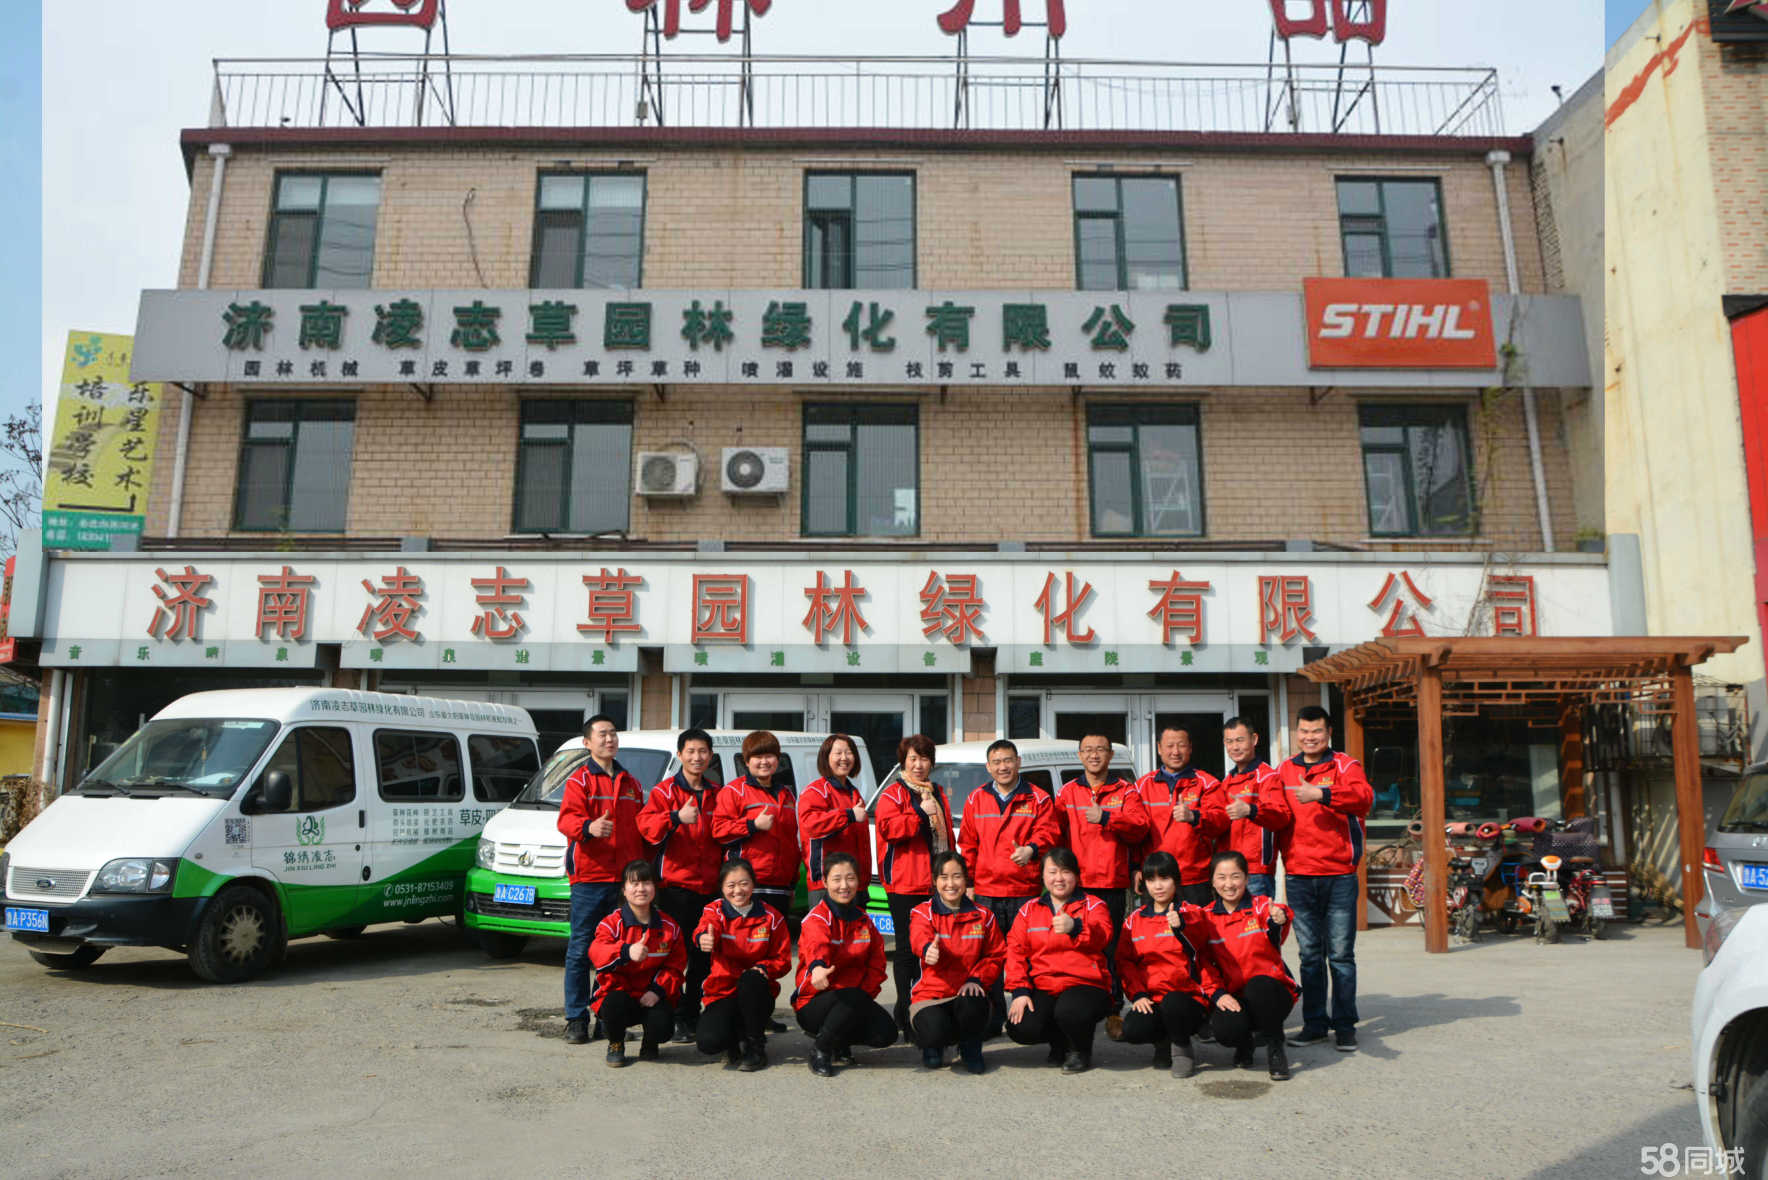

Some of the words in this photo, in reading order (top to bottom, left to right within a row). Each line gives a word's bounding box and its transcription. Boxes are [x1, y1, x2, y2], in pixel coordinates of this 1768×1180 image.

[222, 299, 1213, 354] 济南凌志草园林绿化有限公司
[1318, 303, 1476, 340] STIHL
[244, 359, 359, 378] 园林机械
[399, 359, 546, 378] 草皮草坪卷
[583, 360, 702, 378] 草坪草种
[741, 361, 864, 379] 喷灌设施
[147, 565, 1538, 646] 济南凌志草园林绿化有限公司
